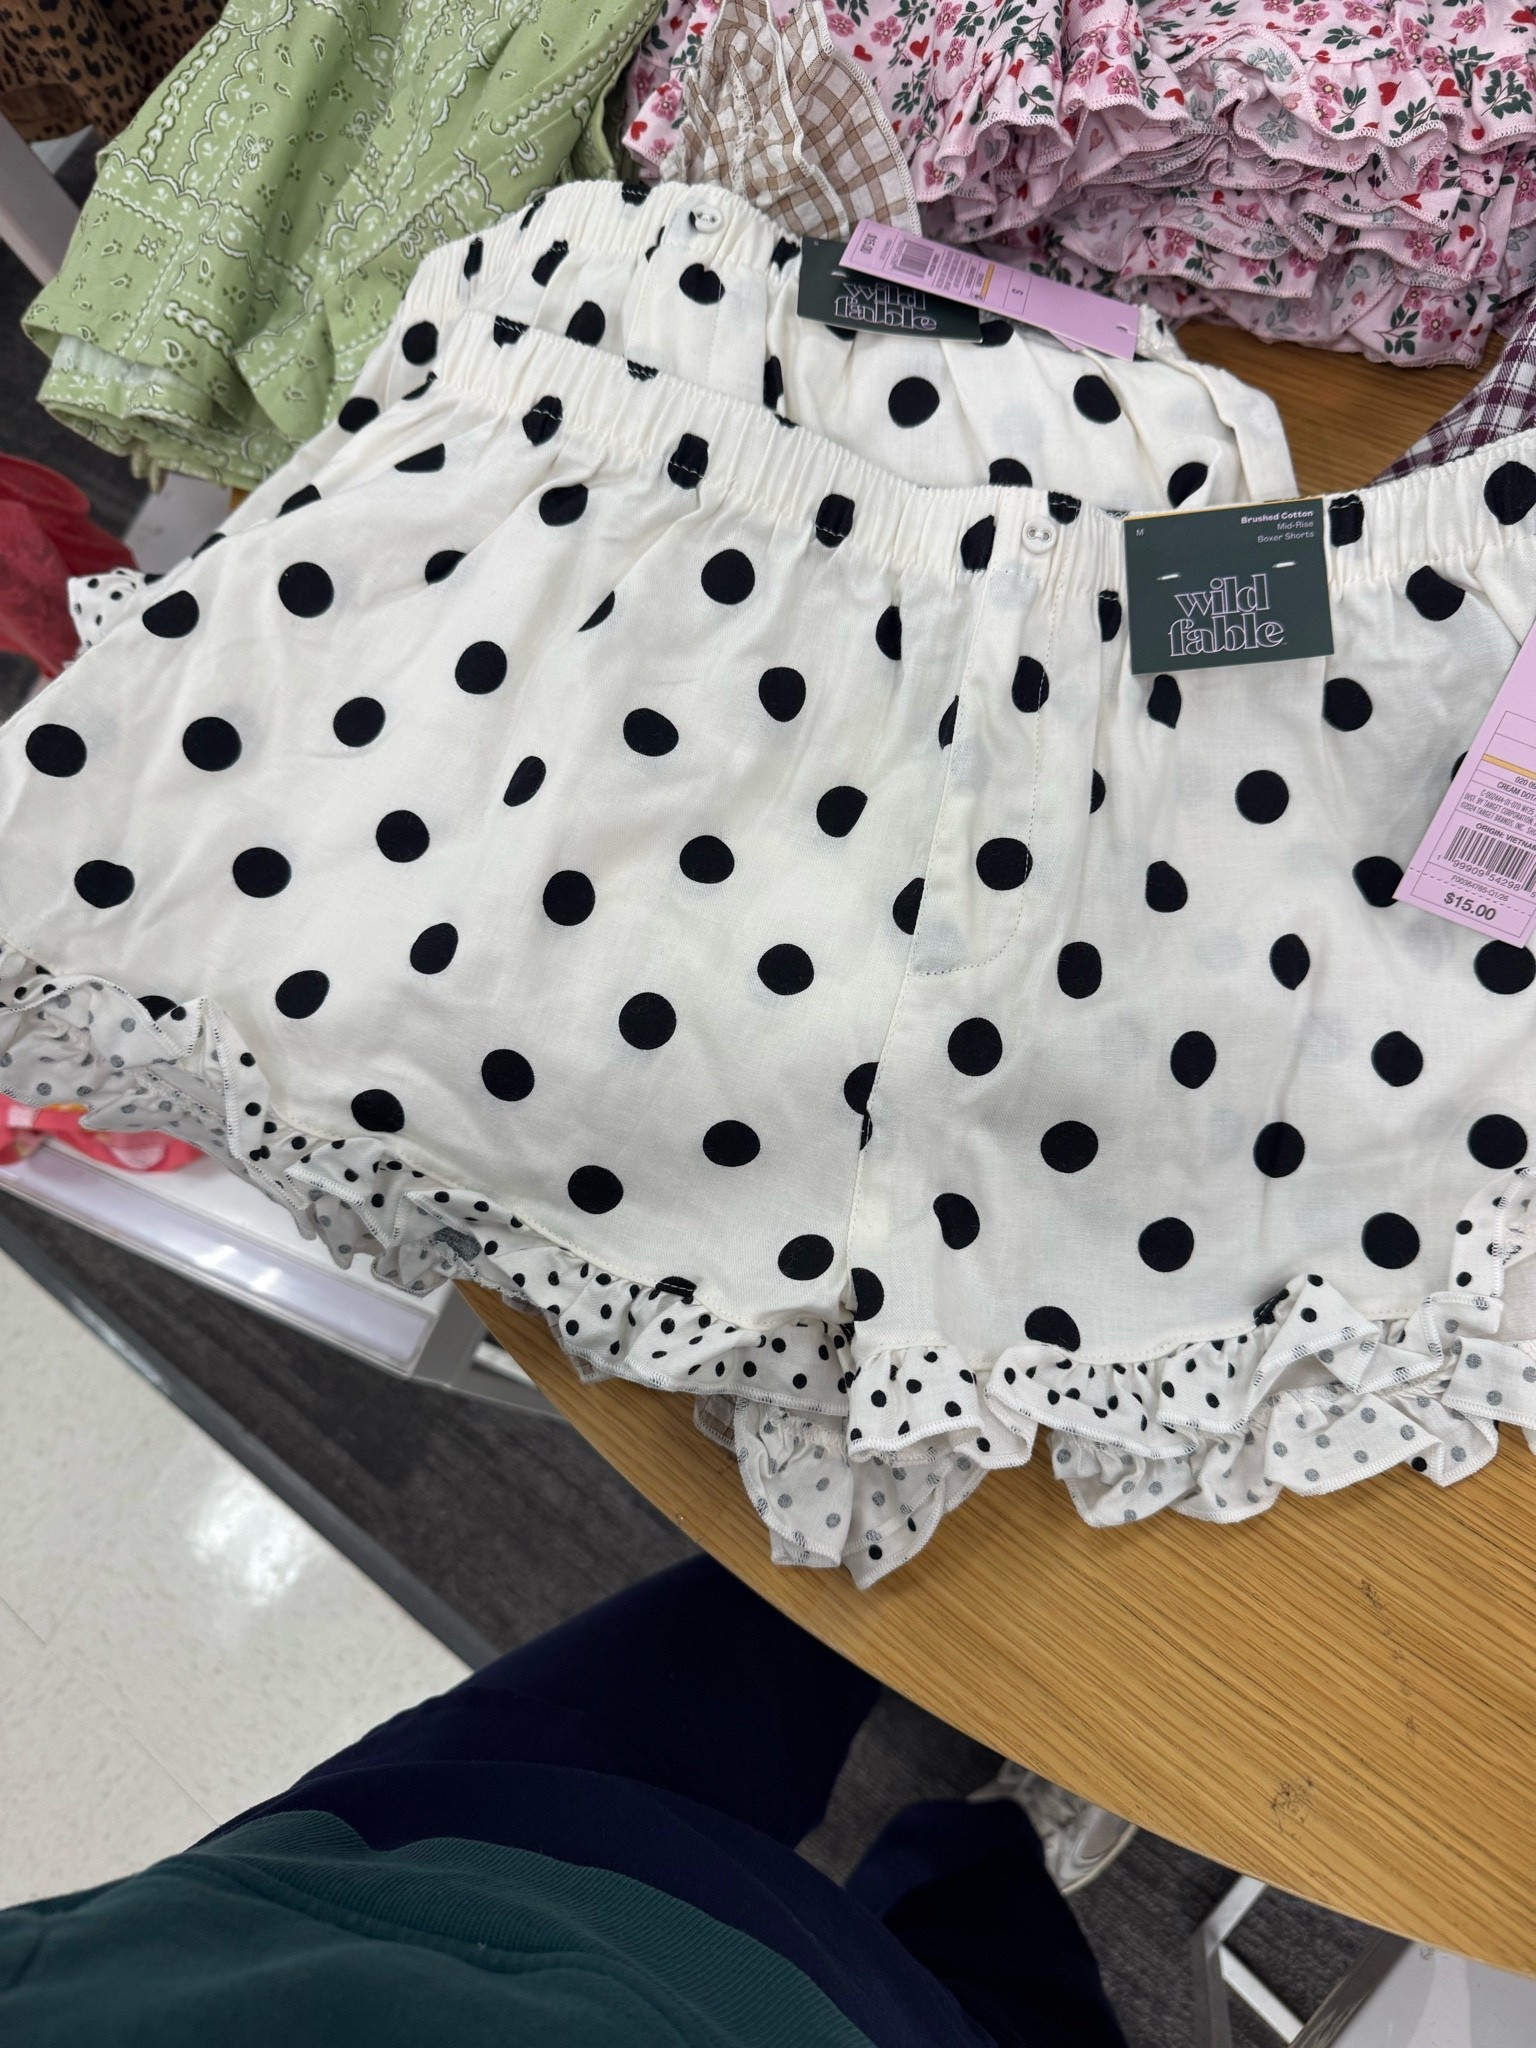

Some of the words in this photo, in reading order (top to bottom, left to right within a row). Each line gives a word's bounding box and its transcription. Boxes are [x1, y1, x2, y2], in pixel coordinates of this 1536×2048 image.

[842, 281, 926, 311] wild
[834, 295, 938, 331] fable
[1240, 511, 1280, 525] Brushed
[1281, 509, 1314, 521] Cotton
[1276, 520, 1314, 531] Mid-Rise
[1136, 528, 1144, 536] M
[1257, 534, 1284, 544] Boxer
[1284, 530, 1315, 541] Shorts
[1174, 573, 1271, 618] wild
[1168, 612, 1286, 657] fable
[1514, 776, 1529, 787] 020
[1496, 781, 1521, 796] CREAM
[1520, 790, 1536, 802] DOT
[1476, 806, 1495, 819] TARGET
[1483, 800, 1502, 812] TARGET
[1475, 822, 1505, 839] ORIGIN:
[1452, 859, 1485, 878] 99909
[1487, 873, 1521, 892] 54298
[1443, 891, 1497, 921] $15.00
